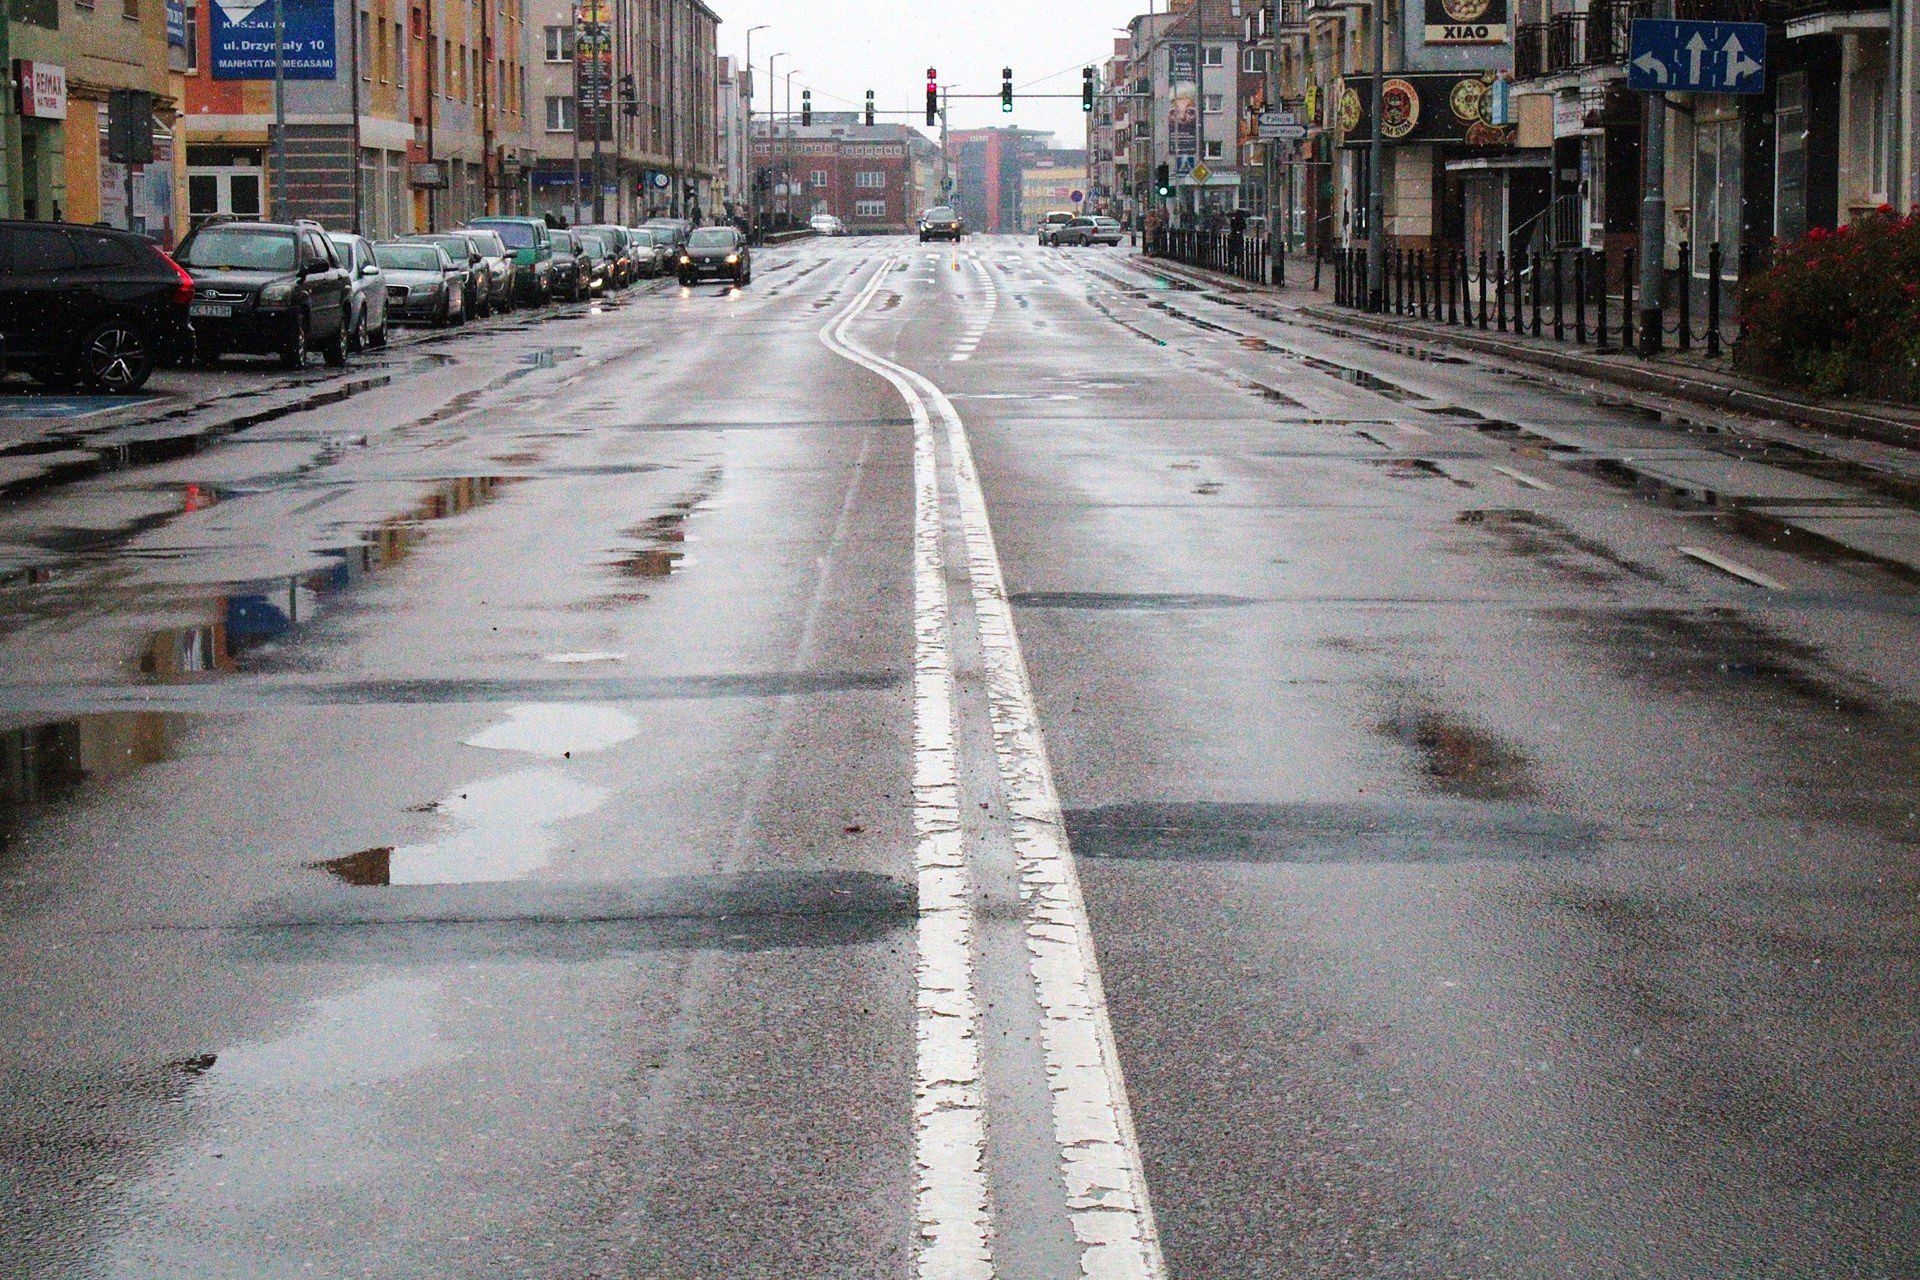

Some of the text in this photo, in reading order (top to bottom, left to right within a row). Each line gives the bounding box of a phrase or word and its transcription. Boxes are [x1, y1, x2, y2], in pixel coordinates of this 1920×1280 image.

[1443, 25, 1489, 39] XIAO
[223, 41, 239, 51] ul.
[309, 40, 325, 50] 10
[1394, 120, 1412, 135] SUM
